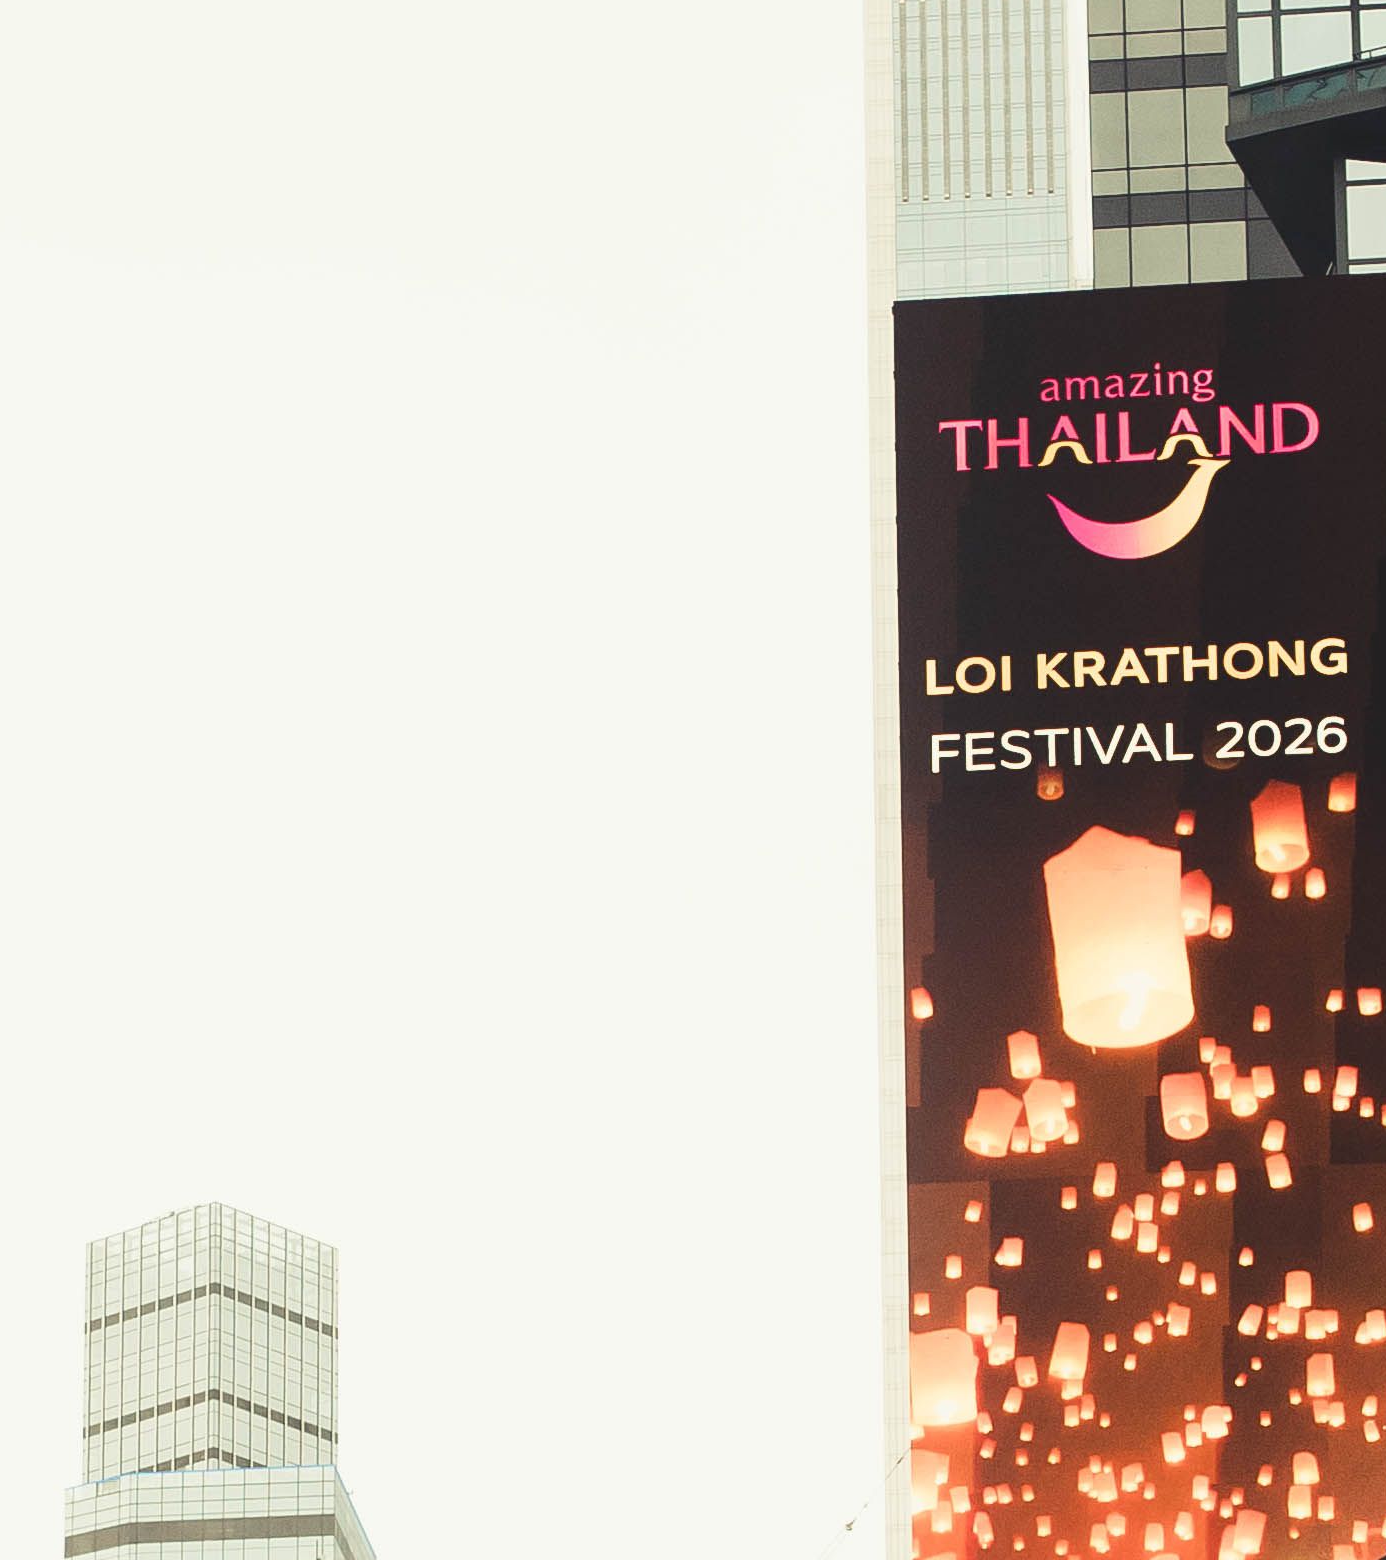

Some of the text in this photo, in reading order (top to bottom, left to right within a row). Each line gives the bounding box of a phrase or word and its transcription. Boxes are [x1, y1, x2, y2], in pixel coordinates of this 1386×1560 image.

[1039, 362, 1216, 402] amazing
[938, 402, 1320, 472] THAILAND
[925, 637, 1349, 697] LOI KRATHONG
[929, 715, 1349, 774] FESTIVAL 2026
